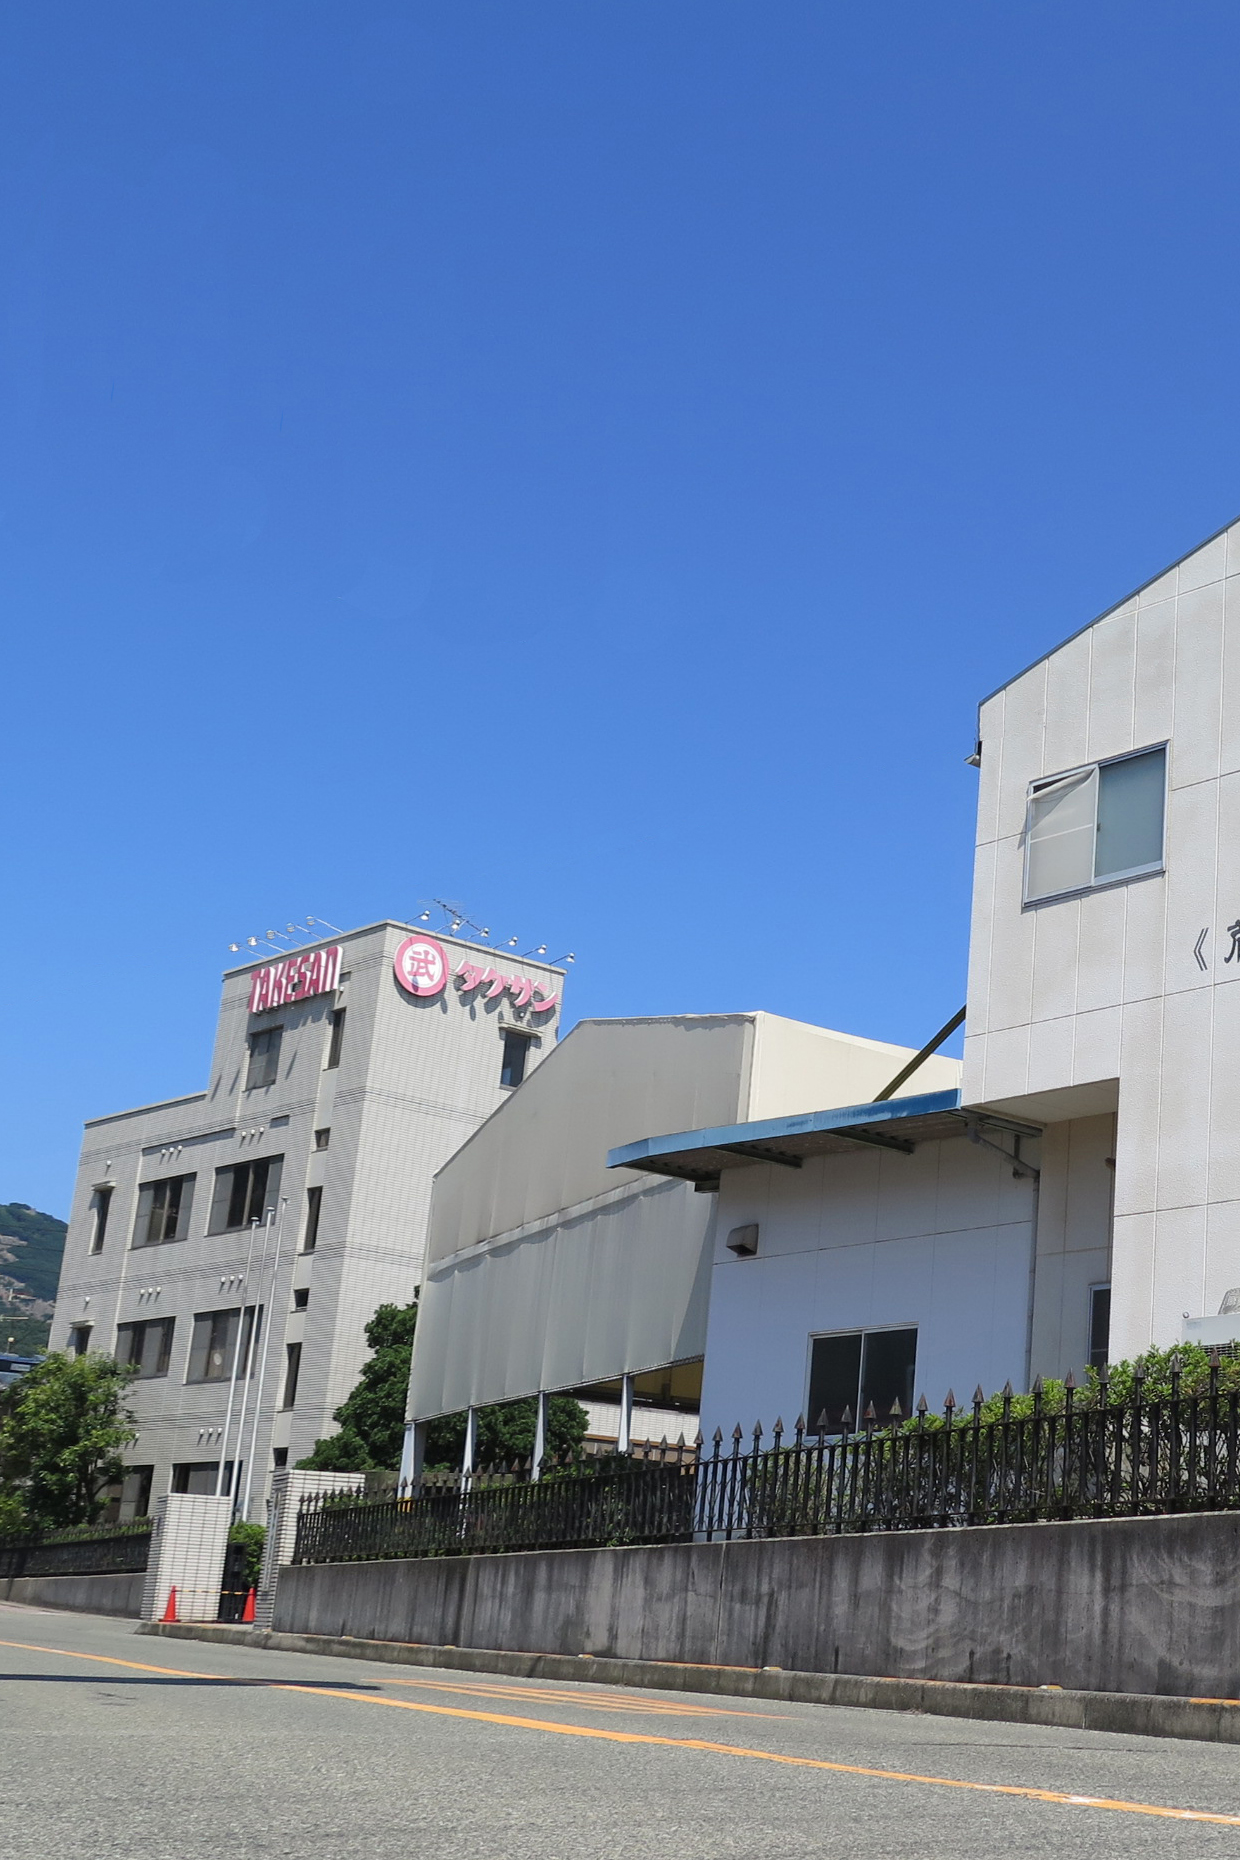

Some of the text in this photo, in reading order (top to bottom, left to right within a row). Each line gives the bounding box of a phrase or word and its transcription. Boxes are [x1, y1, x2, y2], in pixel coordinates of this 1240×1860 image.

[248, 945, 343, 1014] TAKESAN
[407, 949, 436, 982] 武
[455, 959, 559, 1012] タケサン
